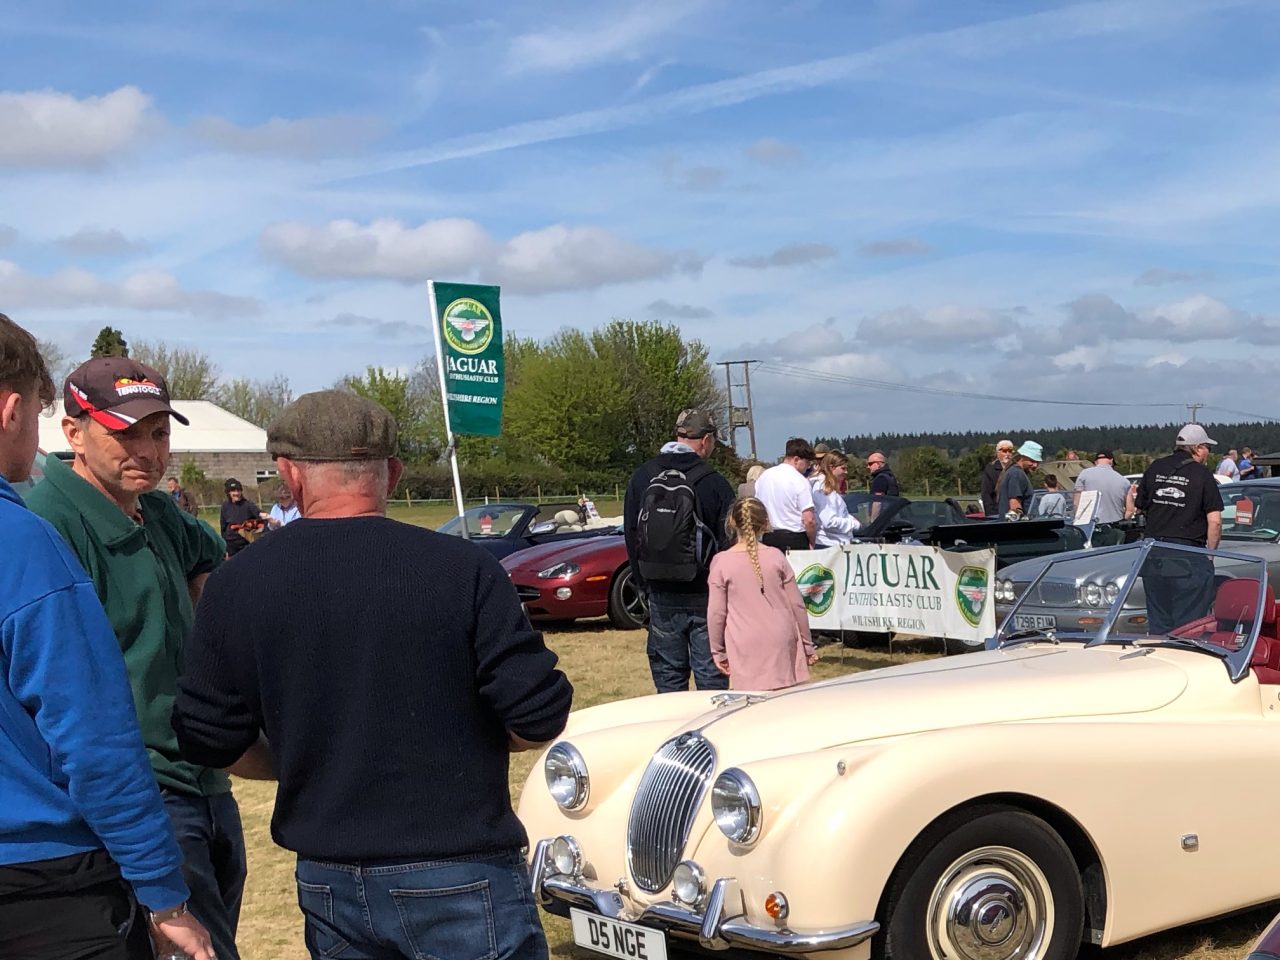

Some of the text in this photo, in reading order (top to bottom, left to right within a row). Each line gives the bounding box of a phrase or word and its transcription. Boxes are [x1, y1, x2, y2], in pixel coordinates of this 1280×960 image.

[843, 551, 940, 596] JAGUAR
[916, 595, 942, 611] CLUB
[852, 615, 926, 630] WILTSHIRE REGION
[588, 918, 648, 960] D5 NGE
